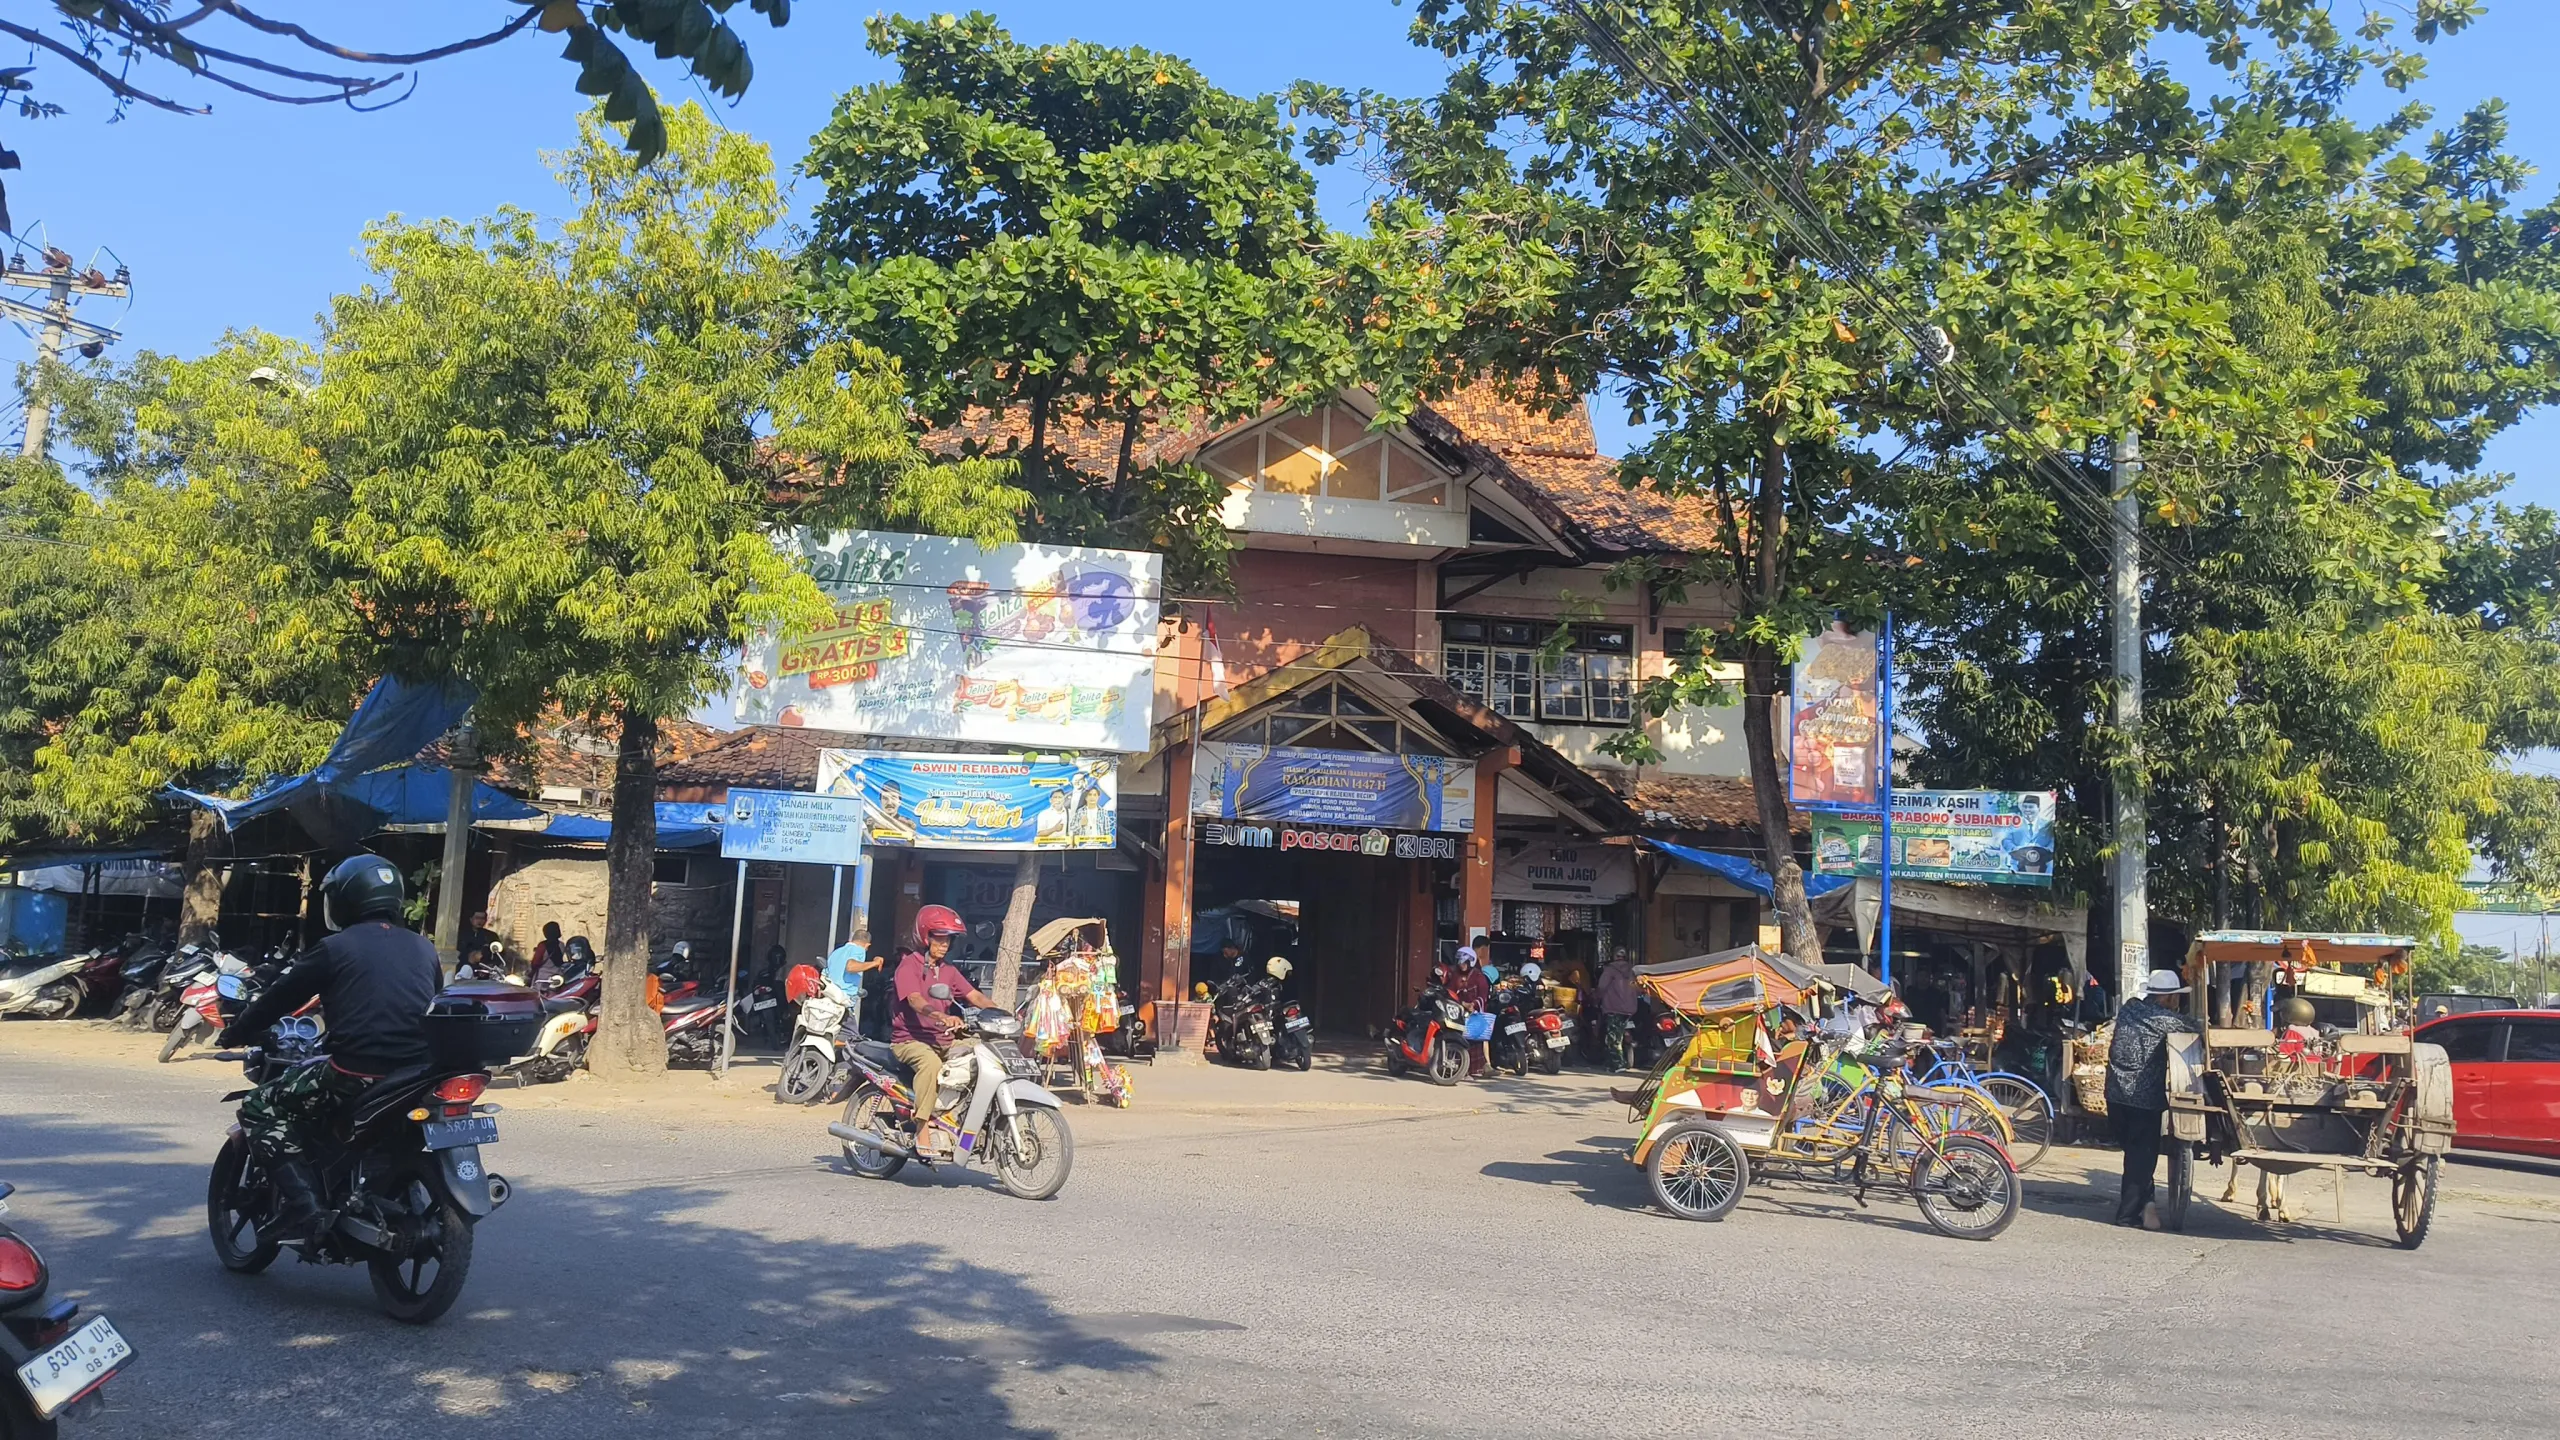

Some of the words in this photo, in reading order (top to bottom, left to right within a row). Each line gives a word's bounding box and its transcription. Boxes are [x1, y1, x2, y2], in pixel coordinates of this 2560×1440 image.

[979, 595, 1023, 630] Jelita
[782, 635, 881, 671] GRATIS
[863, 684, 887, 697] Kulit
[967, 684, 994, 696] Jelita
[858, 697, 889, 709] Wangi
[1022, 692, 1048, 704] Jelita
[1076, 692, 1101, 704] Jelita
[1814, 706, 1869, 727] Sempurna
[912, 763, 957, 774] ASWIN
[961, 763, 1030, 775] REMBANG
[1283, 766, 1307, 774] SELAMAT
[1282, 774, 1350, 789] RAMADHAN
[780, 800, 808, 809] TANAH
[811, 801, 833, 810] MILIK
[1891, 796, 1932, 809] ERIMA
[1937, 797, 1980, 809] KASIH
[795, 811, 828, 820] KABUPATEN
[828, 814, 857, 822] REMBANG
[1890, 812, 1949, 824] PRABOWO
[1954, 814, 2021, 827] SUBIANTO
[1892, 826, 1918, 835] TELAH
[1963, 829, 1992, 838] HARGA
[1417, 837, 1455, 859] BRI
[1914, 857, 1943, 866] JAGUNG
[1959, 858, 2000, 868] SINGKONG
[1527, 865, 1564, 880] PUTRA
[1567, 867, 1598, 882] JAGO
[1901, 870, 1945, 880] KABUPATEN
[1945, 873, 1982, 881] REMBANG
[1902, 889, 1938, 901] JAYA
[428, 1123, 436, 1136] K
[24, 1368, 41, 1389] K
[47, 1340, 86, 1374] 6301
[89, 1320, 115, 1344] UW
